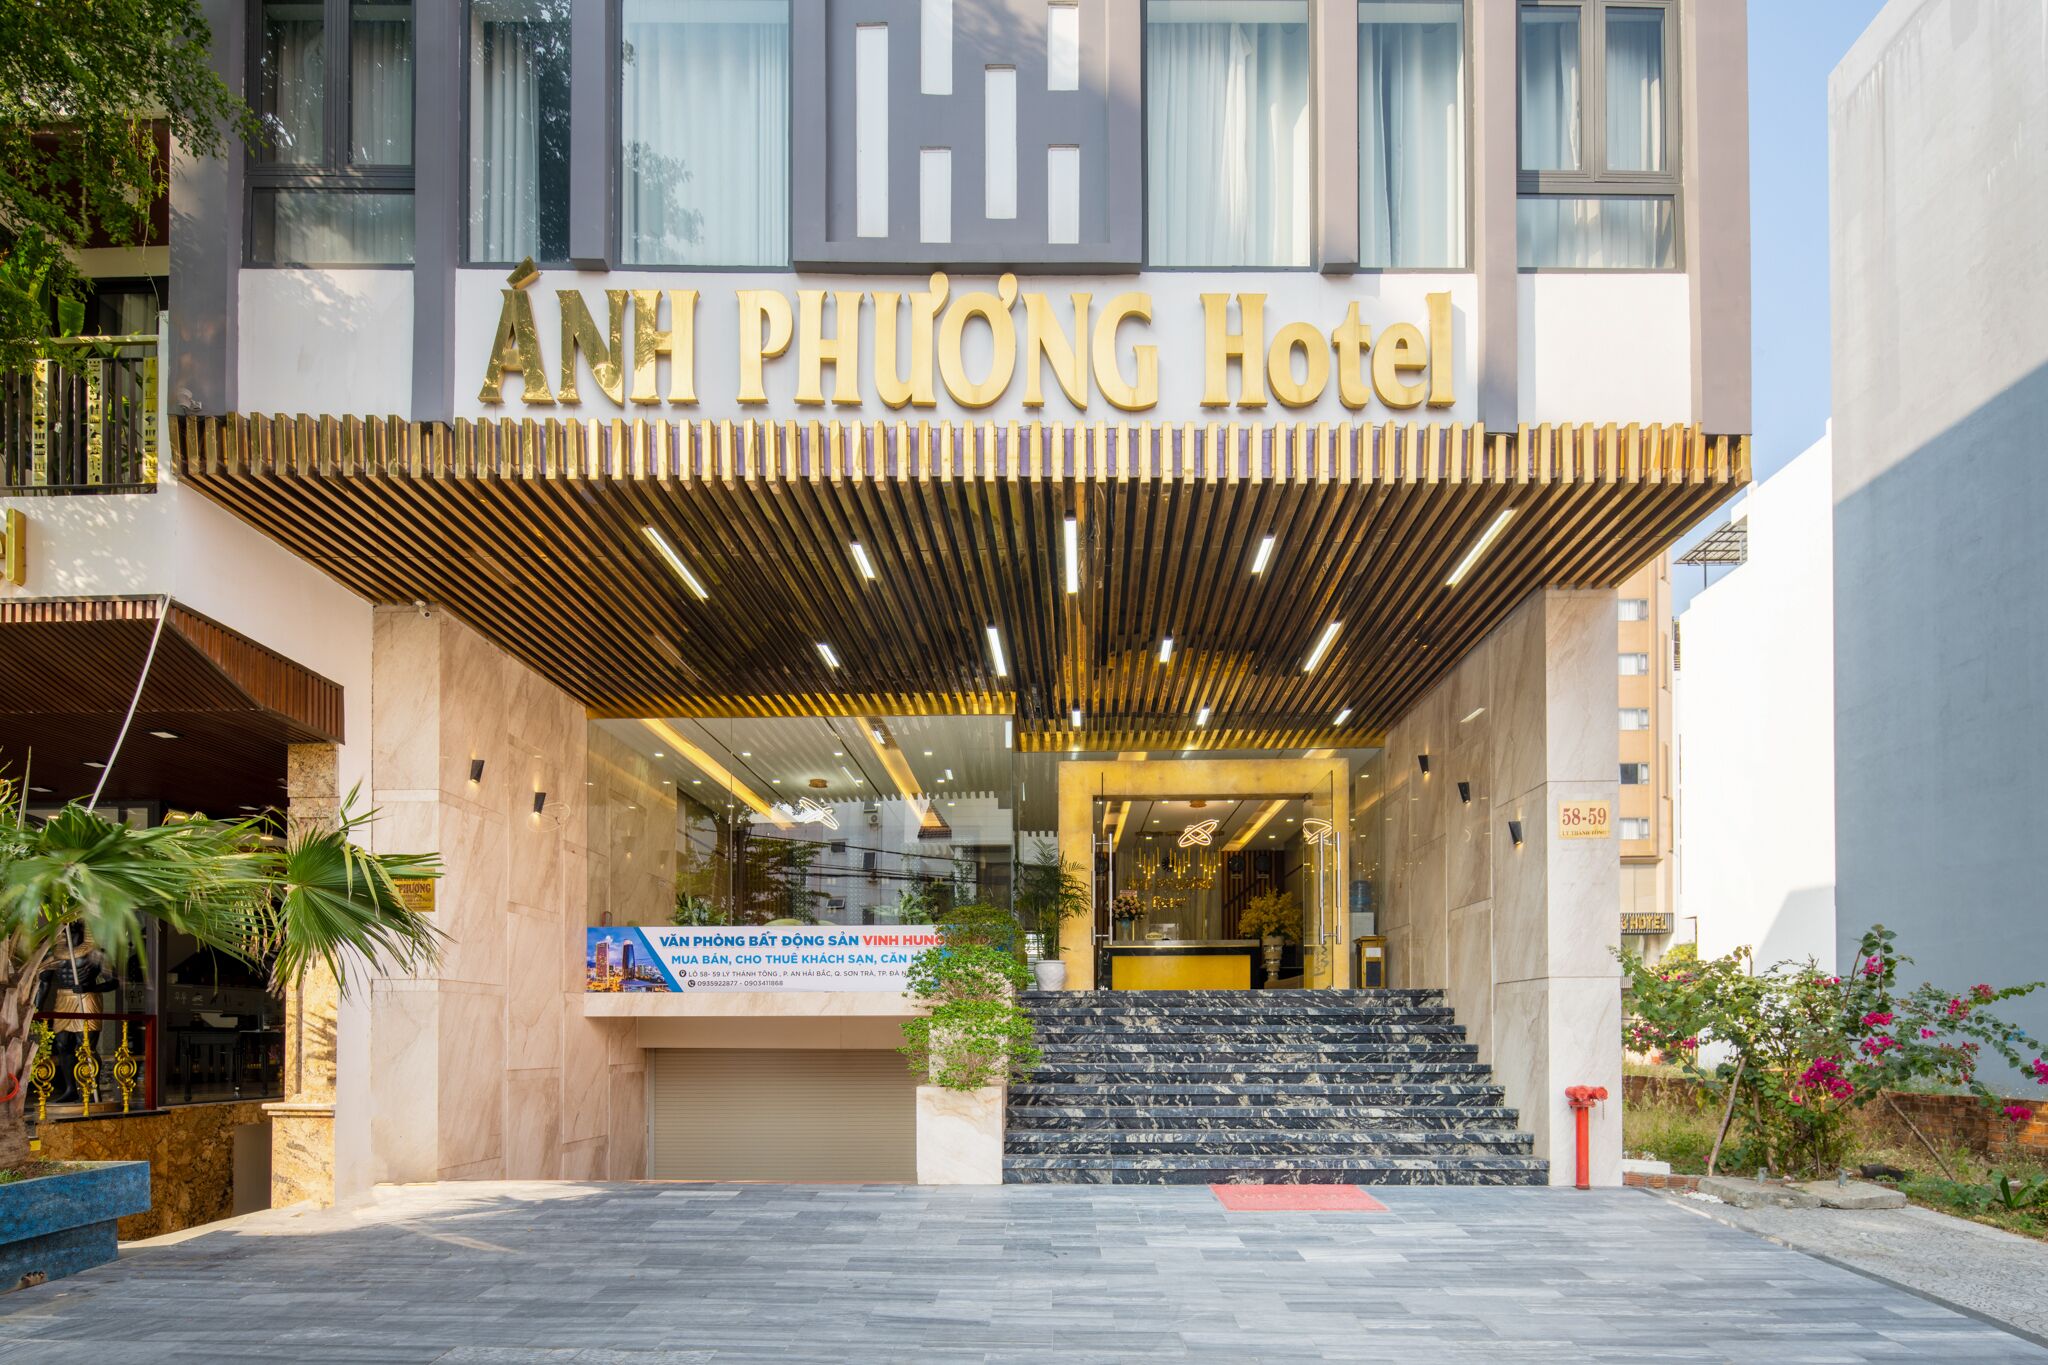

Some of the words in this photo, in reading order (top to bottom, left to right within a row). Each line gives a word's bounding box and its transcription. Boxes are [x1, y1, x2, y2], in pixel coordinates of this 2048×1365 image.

[477, 256, 701, 408] ÁNH
[736, 271, 1158, 411] PHƯƠNG
[1199, 290, 1456, 410] Hotel
[1562, 807, 1607, 826] 58-59
[1630, 915, 1666, 929] HOTEL
[659, 933, 690, 947] VĂN
[693, 933, 745, 947] PHÒNG
[749, 931, 778, 947] BẤT
[781, 932, 825, 949] ĐỘNG
[828, 931, 859, 946] SẢN
[863, 934, 899, 946] VINH
[671, 955, 698, 965] MUA
[702, 953, 732, 965] BÁN,
[735, 955, 762, 965] CHO
[765, 952, 798, 964] THUÊ
[802, 952, 845, 964] KHÁCH
[848, 954, 877, 966] SẠN,
[881, 951, 907, 964] CĂN
